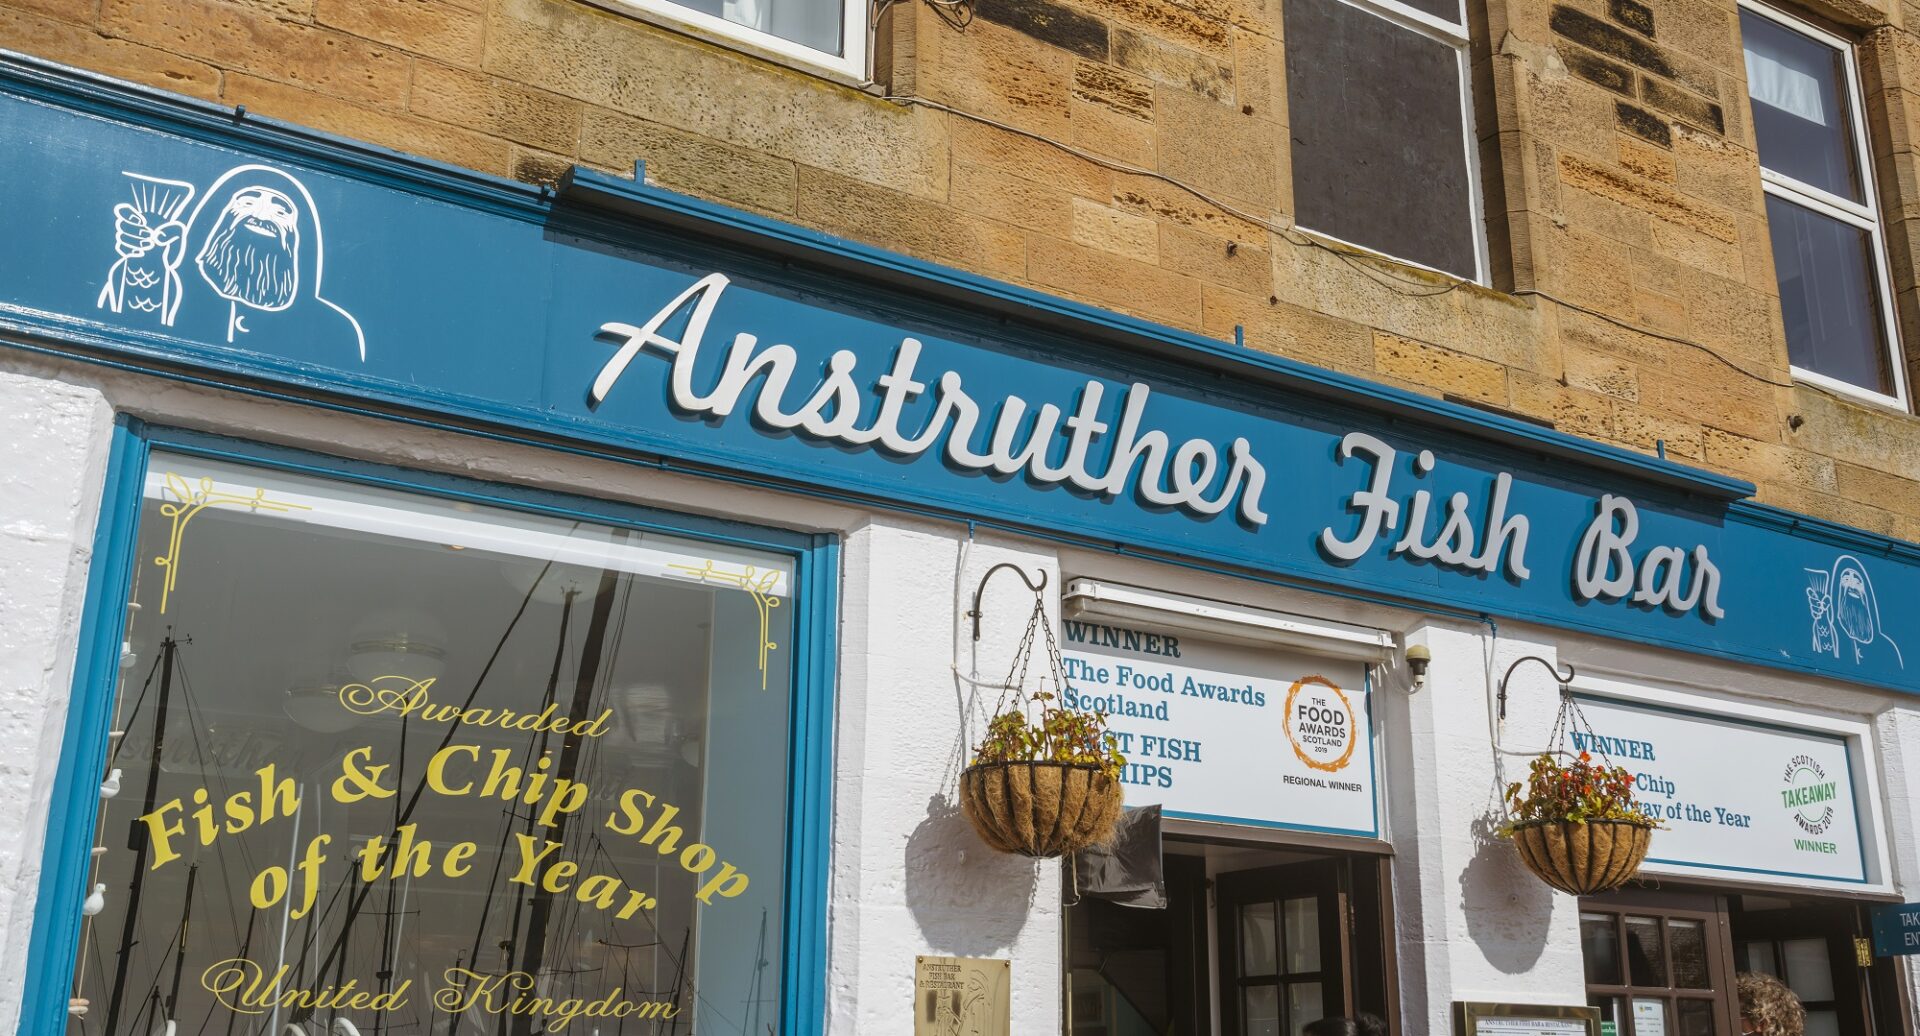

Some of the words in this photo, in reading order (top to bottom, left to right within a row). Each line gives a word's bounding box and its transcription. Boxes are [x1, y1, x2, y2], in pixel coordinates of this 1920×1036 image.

[592, 273, 1267, 525] Anstruther
[1322, 433, 1530, 580] Fish
[1576, 494, 1724, 619] Bar
[1063, 619, 1181, 658] WINNER
[1063, 657, 1110, 684] The
[1116, 665, 1174, 694] Food
[1181, 676, 1265, 707] Awards
[339, 676, 613, 738] Awarded
[1064, 687, 1170, 721] Scotland
[1311, 697, 1326, 706] THE
[1298, 705, 1344, 726] FOOD
[1299, 722, 1345, 738] AWARDS
[1302, 735, 1342, 747] SCOTLAND
[1140, 735, 1202, 762] FISH
[1569, 731, 1656, 761] WINNER
[1118, 763, 1173, 788] HIPS
[1784, 763, 1794, 783] THE
[1792, 754, 1825, 779] SCOTTISH
[1283, 775, 1327, 788] REGIONAL
[1328, 780, 1362, 792] WINNER
[1636, 772, 1675, 799] Chip
[1781, 781, 1837, 808] TAKEAWAY
[138, 764, 301, 871] Fish
[332, 747, 398, 804] &
[427, 745, 590, 828] Chip
[607, 789, 749, 904] Shop
[1667, 802, 1682, 820] of
[1686, 804, 1711, 824] the
[1714, 807, 1751, 828] Year
[1793, 813, 1823, 835] AWARDS
[1822, 806, 1834, 830] 2019
[1793, 838, 1838, 854] WINNER
[250, 834, 333, 920] of
[358, 823, 478, 884] the
[512, 833, 657, 920] Year
[1900, 912, 1920, 926] TAK
[202, 958, 411, 1014] United
[435, 968, 681, 1034] Kingdom
